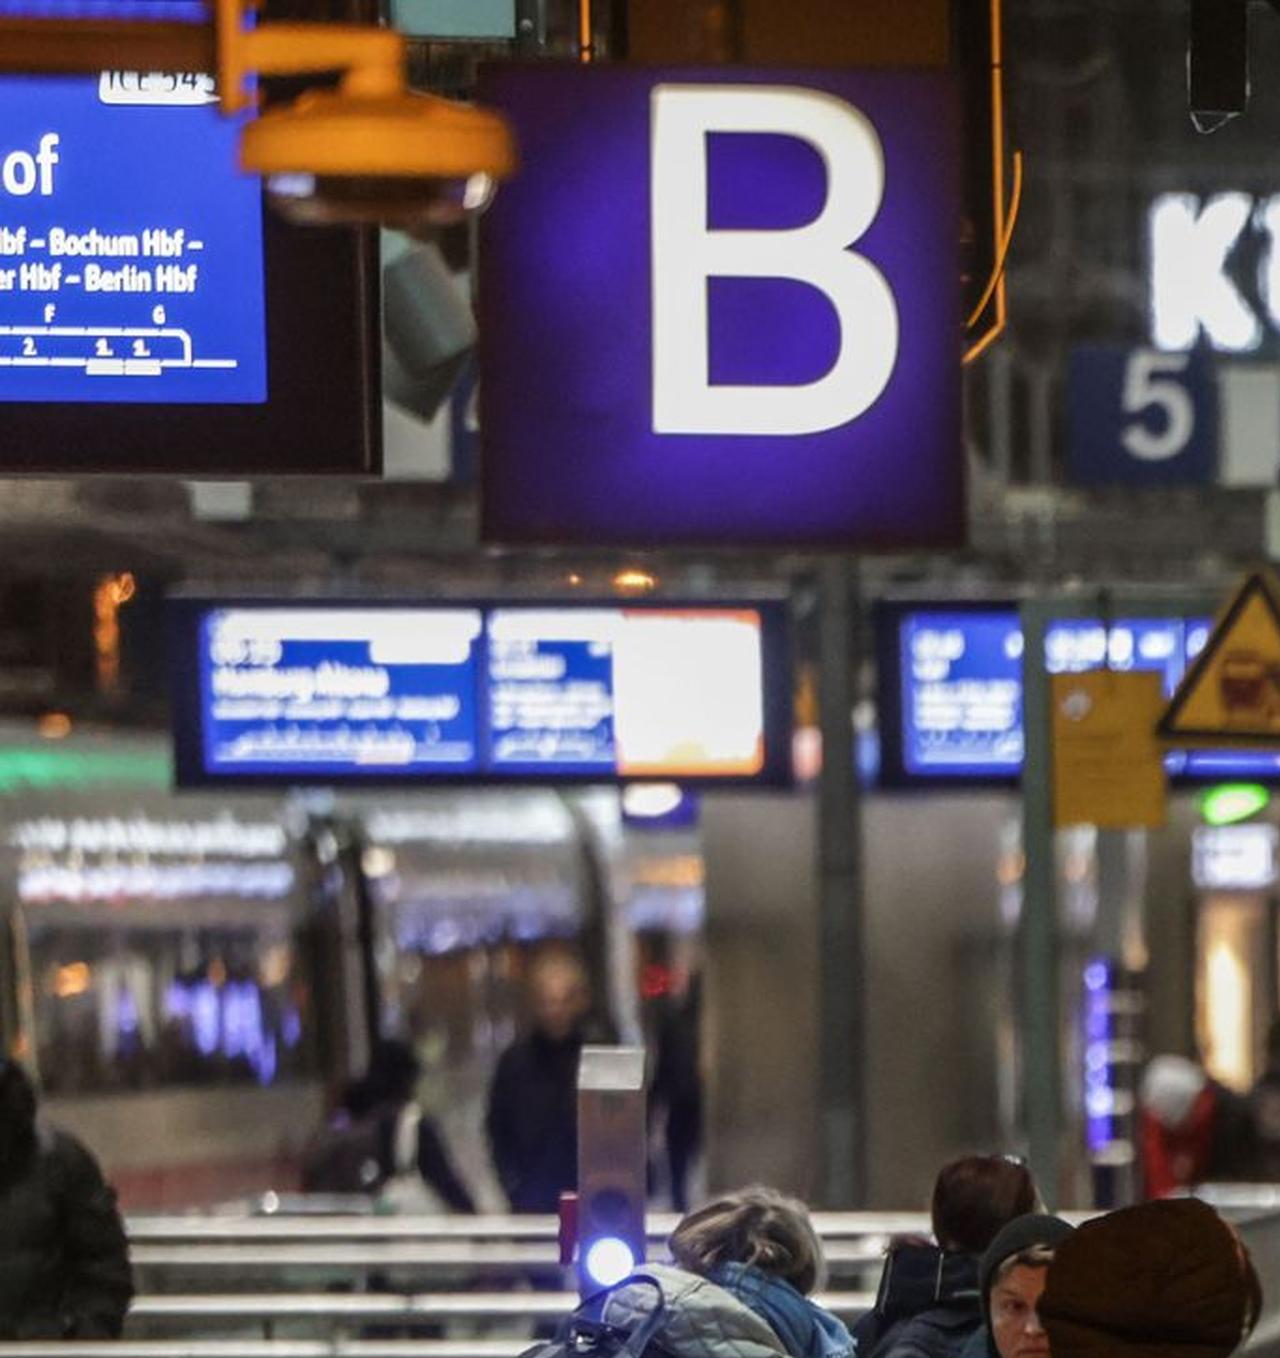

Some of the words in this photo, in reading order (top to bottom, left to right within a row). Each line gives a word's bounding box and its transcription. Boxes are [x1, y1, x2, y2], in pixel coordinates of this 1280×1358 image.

[0, 226, 27, 256] bf
[49, 227, 138, 257] Bochum
[142, 228, 184, 257] Hbf
[651, 83, 899, 435] B
[20, 262, 62, 291] Hbf
[84, 263, 151, 293] Berlin
[155, 264, 198, 293] Hbf
[1121, 351, 1195, 460] 5
